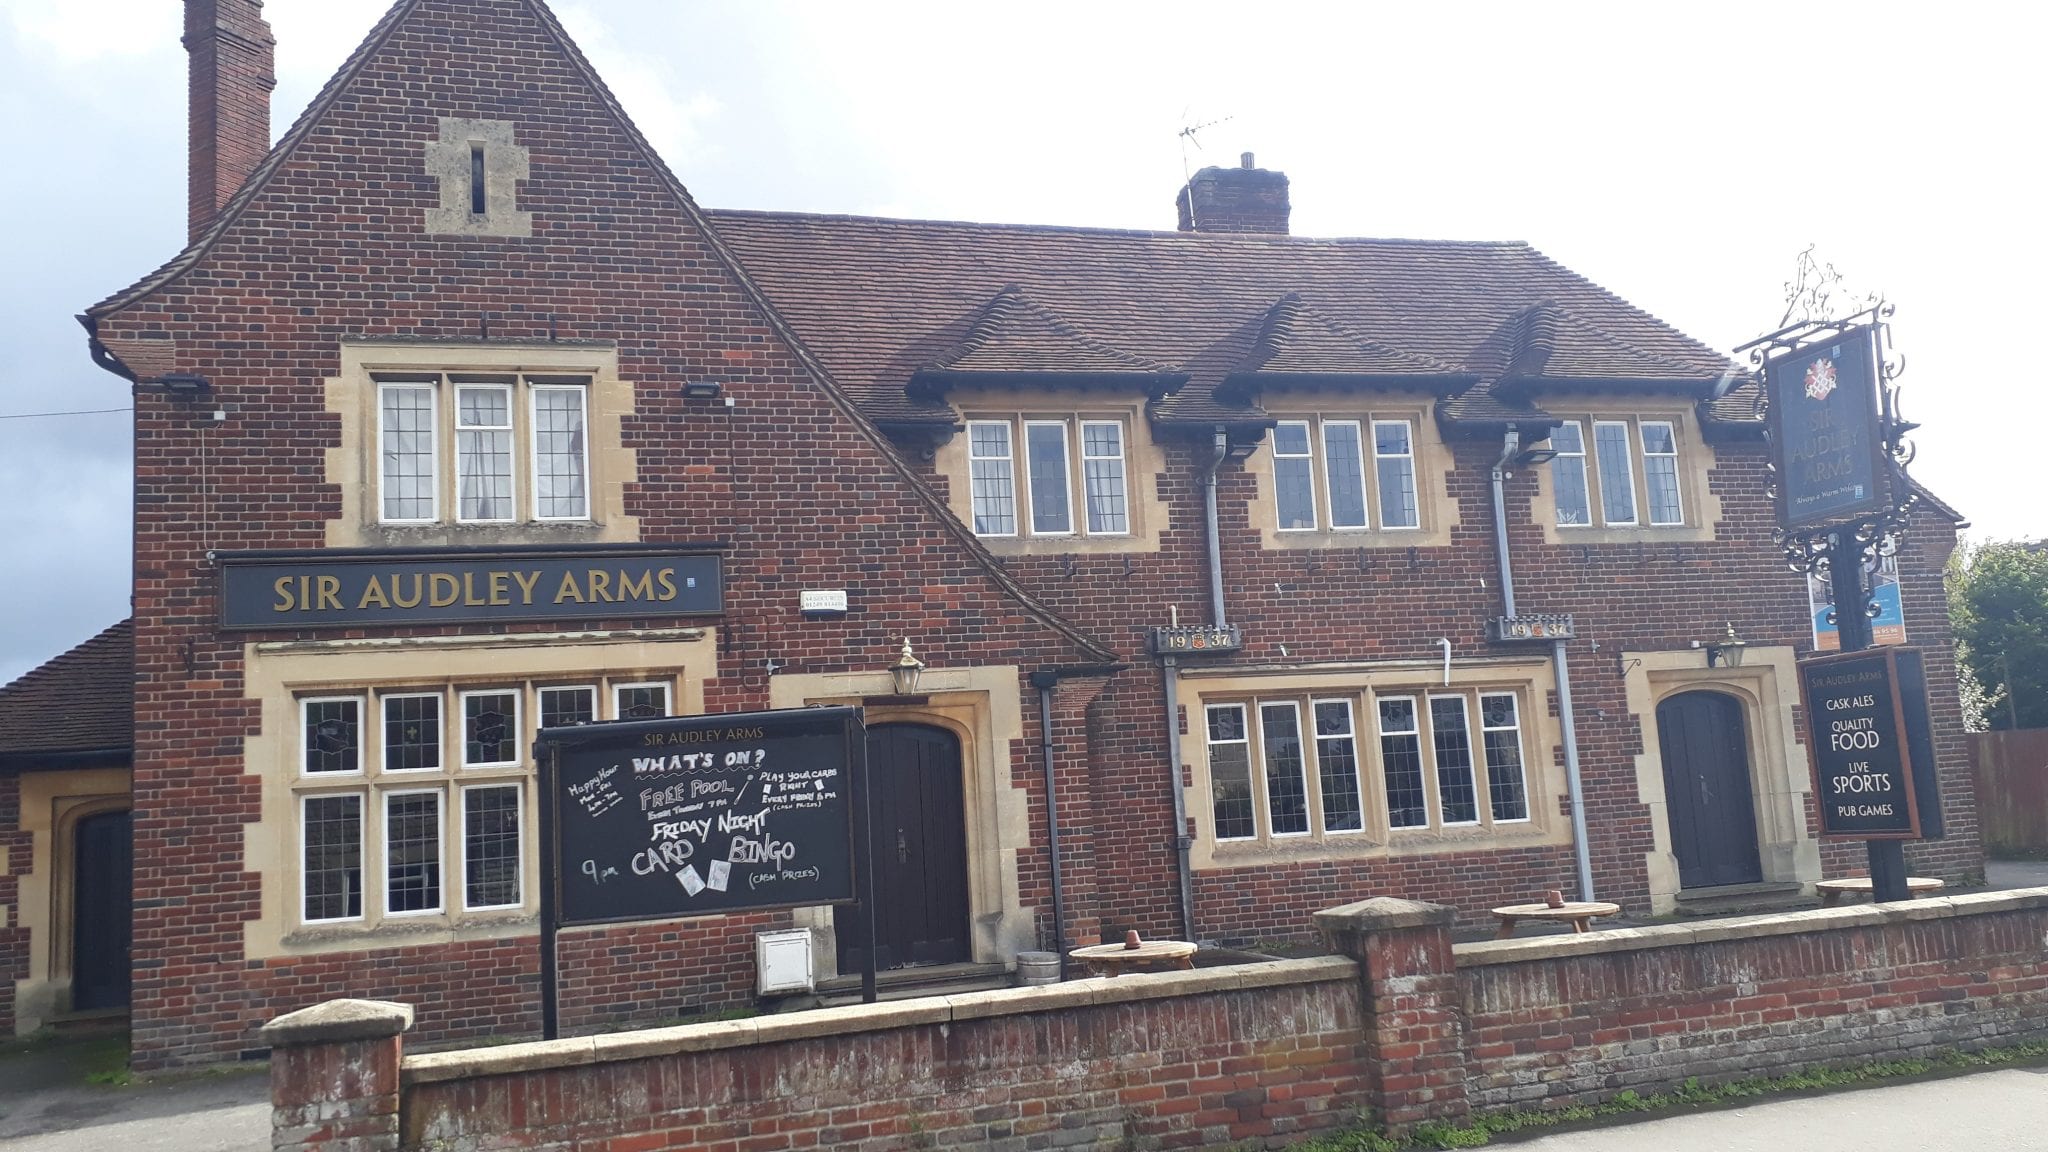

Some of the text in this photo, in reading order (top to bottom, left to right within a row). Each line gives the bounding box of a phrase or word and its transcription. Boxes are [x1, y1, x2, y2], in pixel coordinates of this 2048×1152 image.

[273, 568, 678, 612] SIR AUDLEY ARMS
[1511, 624, 1566, 636] 19 37
[1169, 634, 1229, 648] 19 37
[1826, 695, 1874, 710] CASK ALES
[1832, 717, 1874, 732] QUALITY
[645, 727, 764, 746] SIR AUDLEY ARMS
[1831, 731, 1880, 751] FOOD
[632, 749, 766, 773] WHAT'S ON?
[1848, 761, 1869, 774] LIVE
[568, 764, 619, 796] Happy Hour
[759, 771, 784, 783] PLAY
[787, 771, 812, 782] YOUR
[1833, 773, 1891, 794] SPORTS
[640, 778, 734, 810] FREE POOL
[1838, 803, 1893, 817] PUB GAMES
[651, 807, 771, 842] FRIDAY NIGHT
[632, 832, 796, 876] CARD BINGO
[781, 867, 820, 882] PRIZES)
